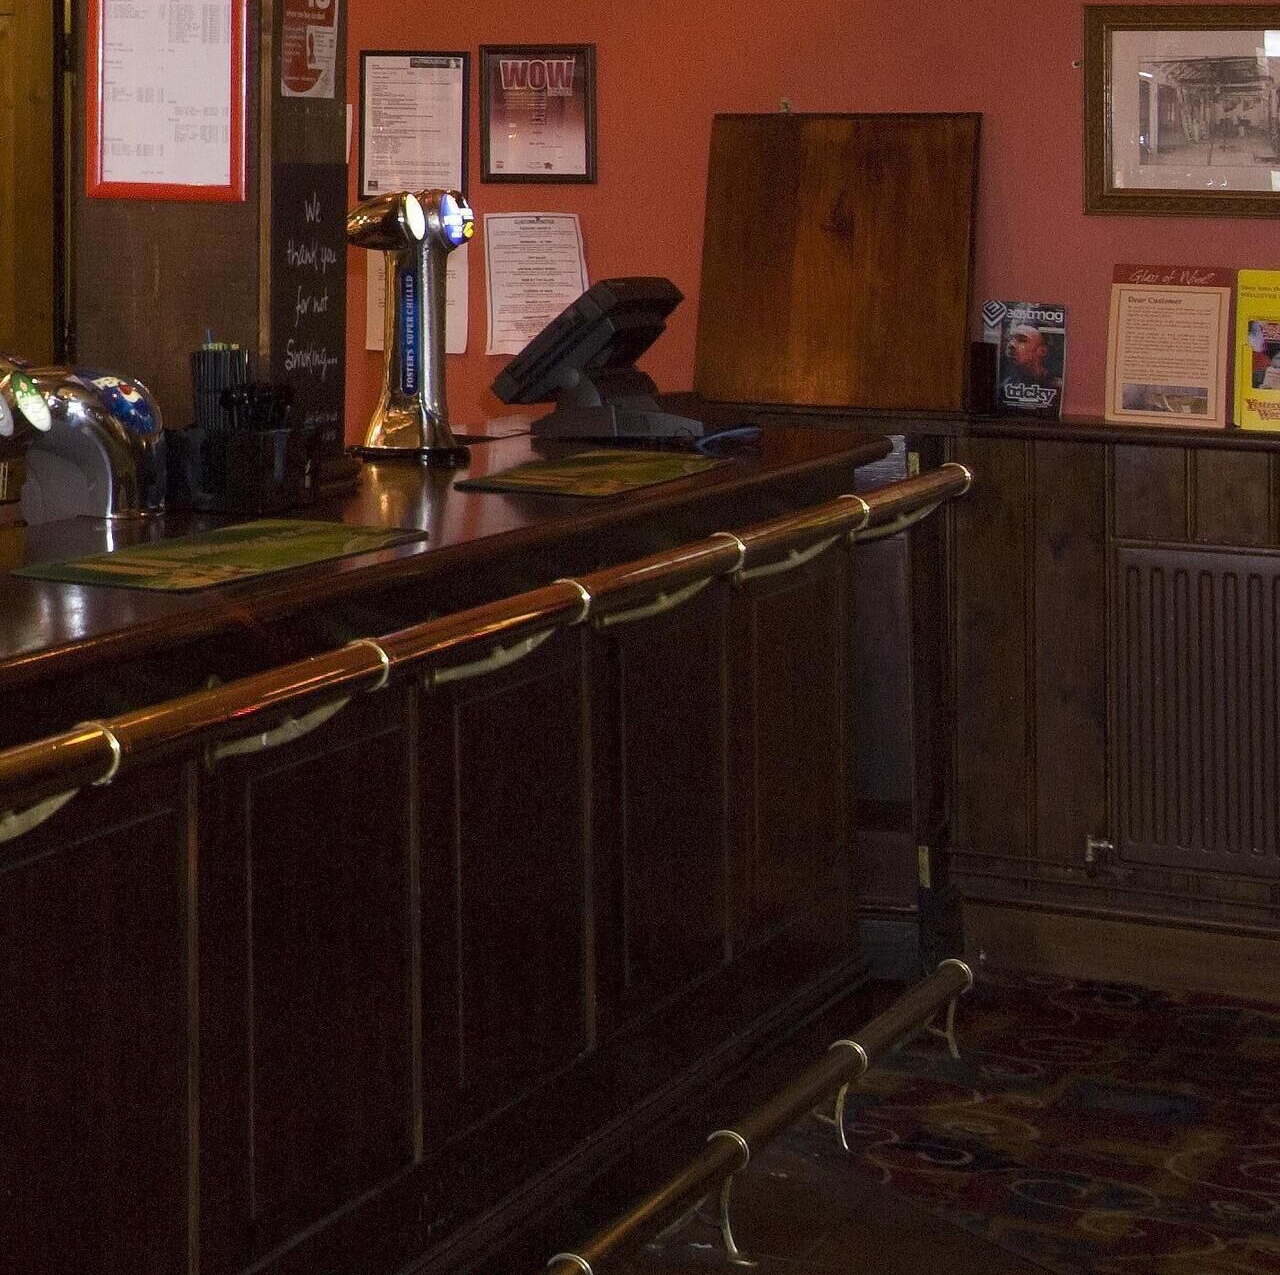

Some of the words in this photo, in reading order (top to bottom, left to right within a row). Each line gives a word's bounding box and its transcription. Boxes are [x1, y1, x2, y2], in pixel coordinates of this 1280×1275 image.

[499, 59, 575, 90] WOW
[304, 194, 322, 224] We
[312, 287, 329, 313] not
[406, 349, 415, 389] FOSTER'S
